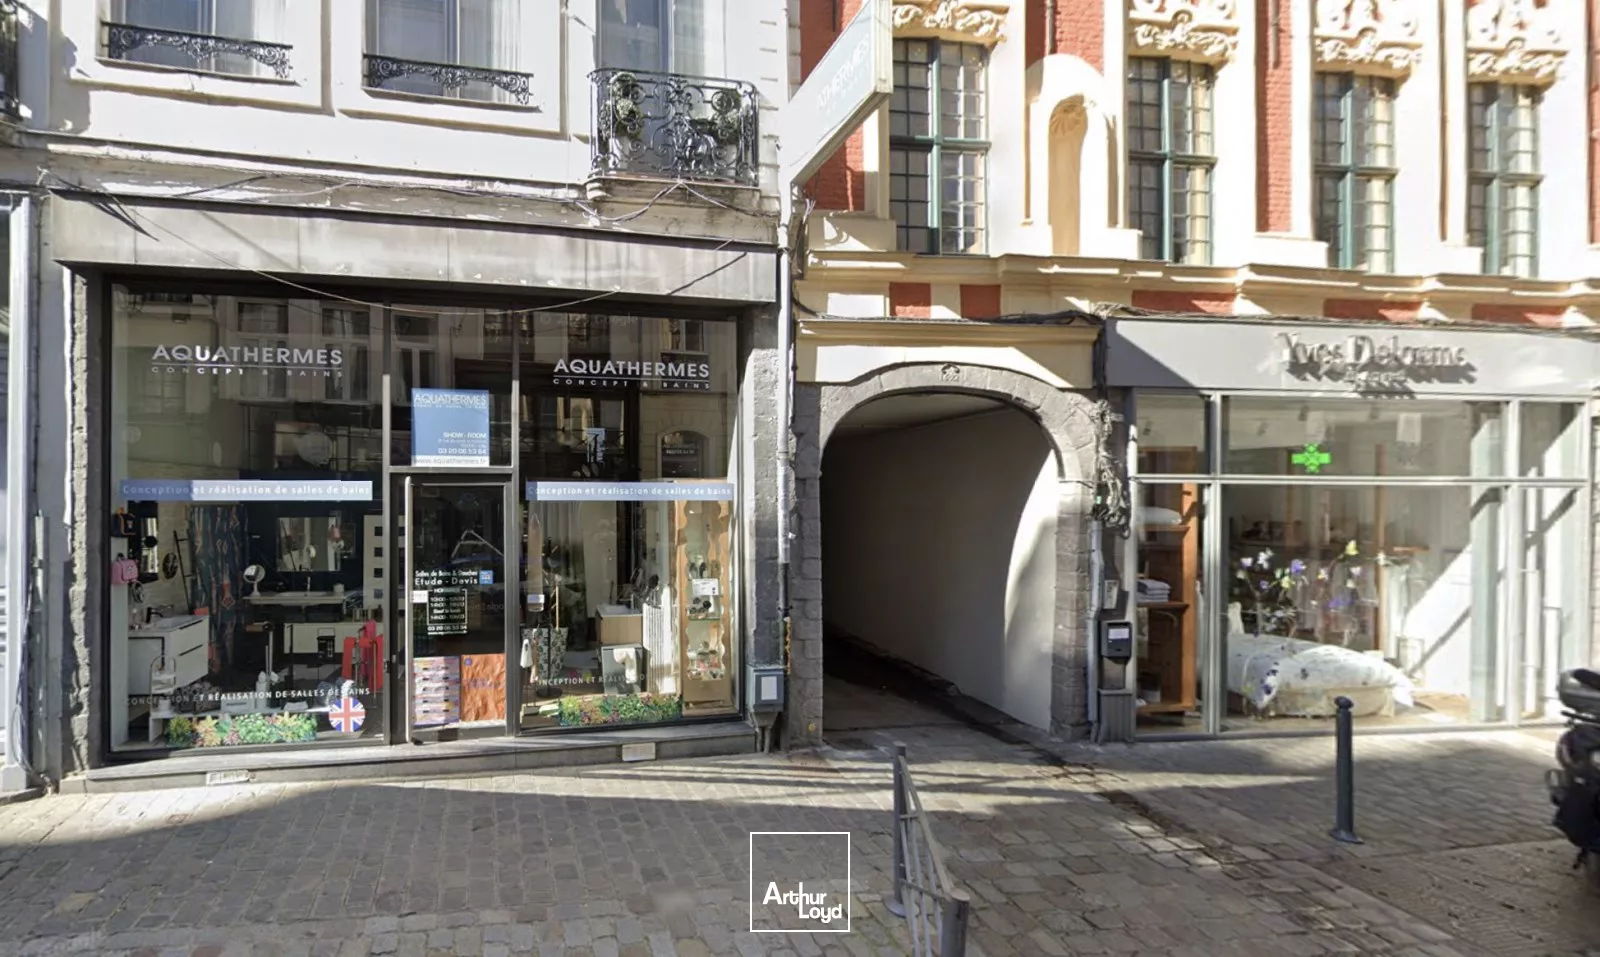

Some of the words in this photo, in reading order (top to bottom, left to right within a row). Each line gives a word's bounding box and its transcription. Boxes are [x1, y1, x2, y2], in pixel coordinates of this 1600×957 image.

[1274, 332, 1343, 364] Yves
[152, 344, 343, 365] AQUATHERMES
[152, 366, 244, 375] CONCEPT
[286, 369, 343, 378] BAINS
[553, 358, 710, 378] AQUATHERMES
[553, 378, 628, 387] CONCEPT
[415, 393, 487, 405] AQUATHERMES
[123, 485, 189, 495] Conception
[193, 485, 205, 494] et
[209, 484, 271, 494] réalisation
[274, 485, 289, 494] de
[291, 485, 322, 494] salles
[326, 485, 340, 494] de
[342, 485, 369, 494] bains
[528, 486, 582, 496] Conception
[597, 486, 649, 495] réalisation
[651, 487, 663, 495] de
[665, 487, 692, 495] salles
[694, 487, 704, 495] de
[707, 487, 732, 495] bains
[415, 577, 443, 585] Etude
[207, 690, 272, 702] RÉALISATION
[275, 690, 286, 698] DE
[291, 689, 325, 698] SALLES
[342, 687, 370, 697] AINS
